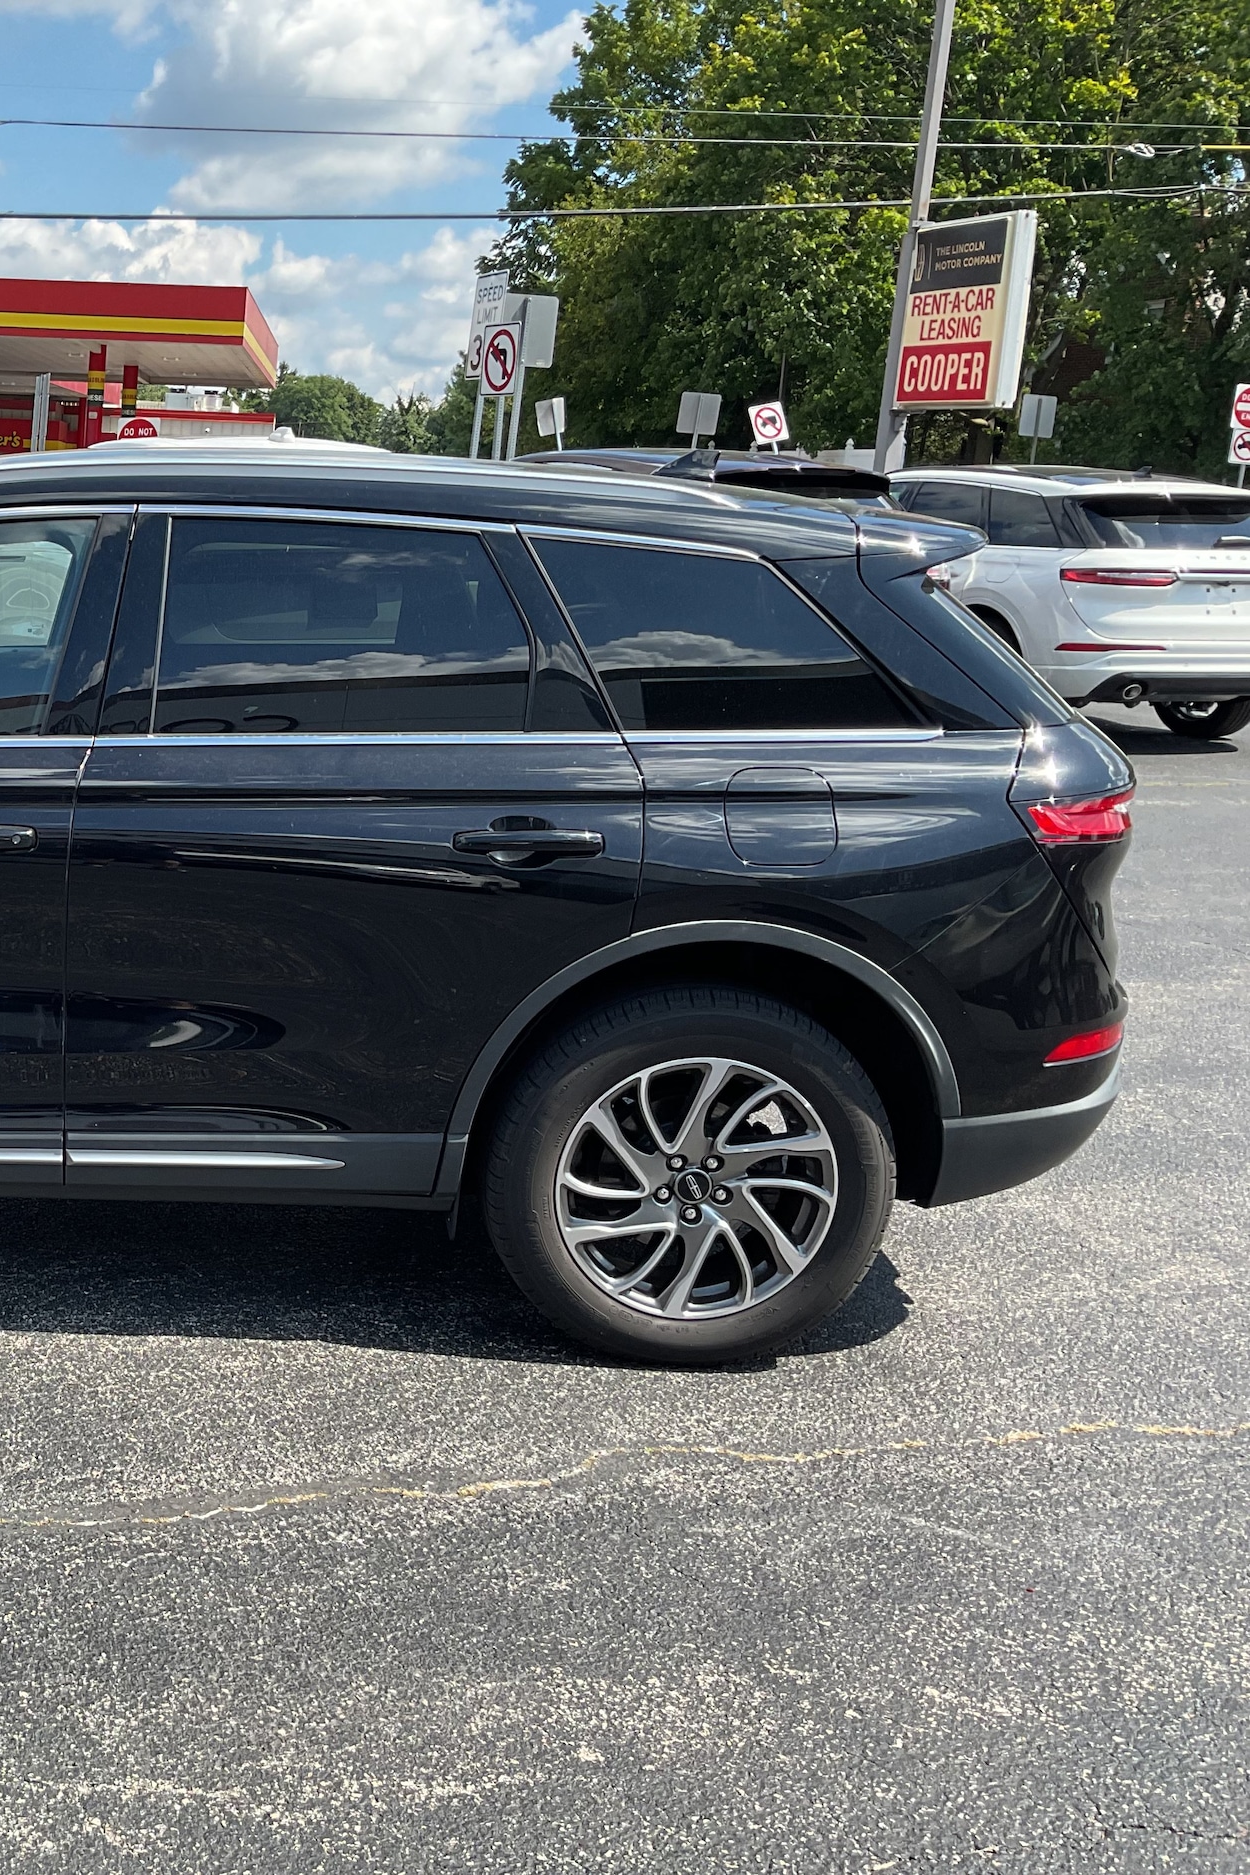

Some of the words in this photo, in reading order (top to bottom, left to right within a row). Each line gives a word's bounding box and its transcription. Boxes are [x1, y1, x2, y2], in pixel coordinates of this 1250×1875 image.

[936, 245, 951, 257] THE
[951, 240, 986, 255] LINCOLN
[935, 259, 961, 271] MOTOR
[963, 253, 1002, 268] COMPANY
[477, 285, 504, 303] SPEED
[911, 287, 996, 317] RENT-A-CAR
[477, 306, 498, 324] LIMIT
[919, 315, 982, 342] LEASING
[471, 335, 482, 370] 3
[904, 352, 985, 392] COOPER
[124, 428, 135, 436] DO
[138, 427, 154, 436] NOT
